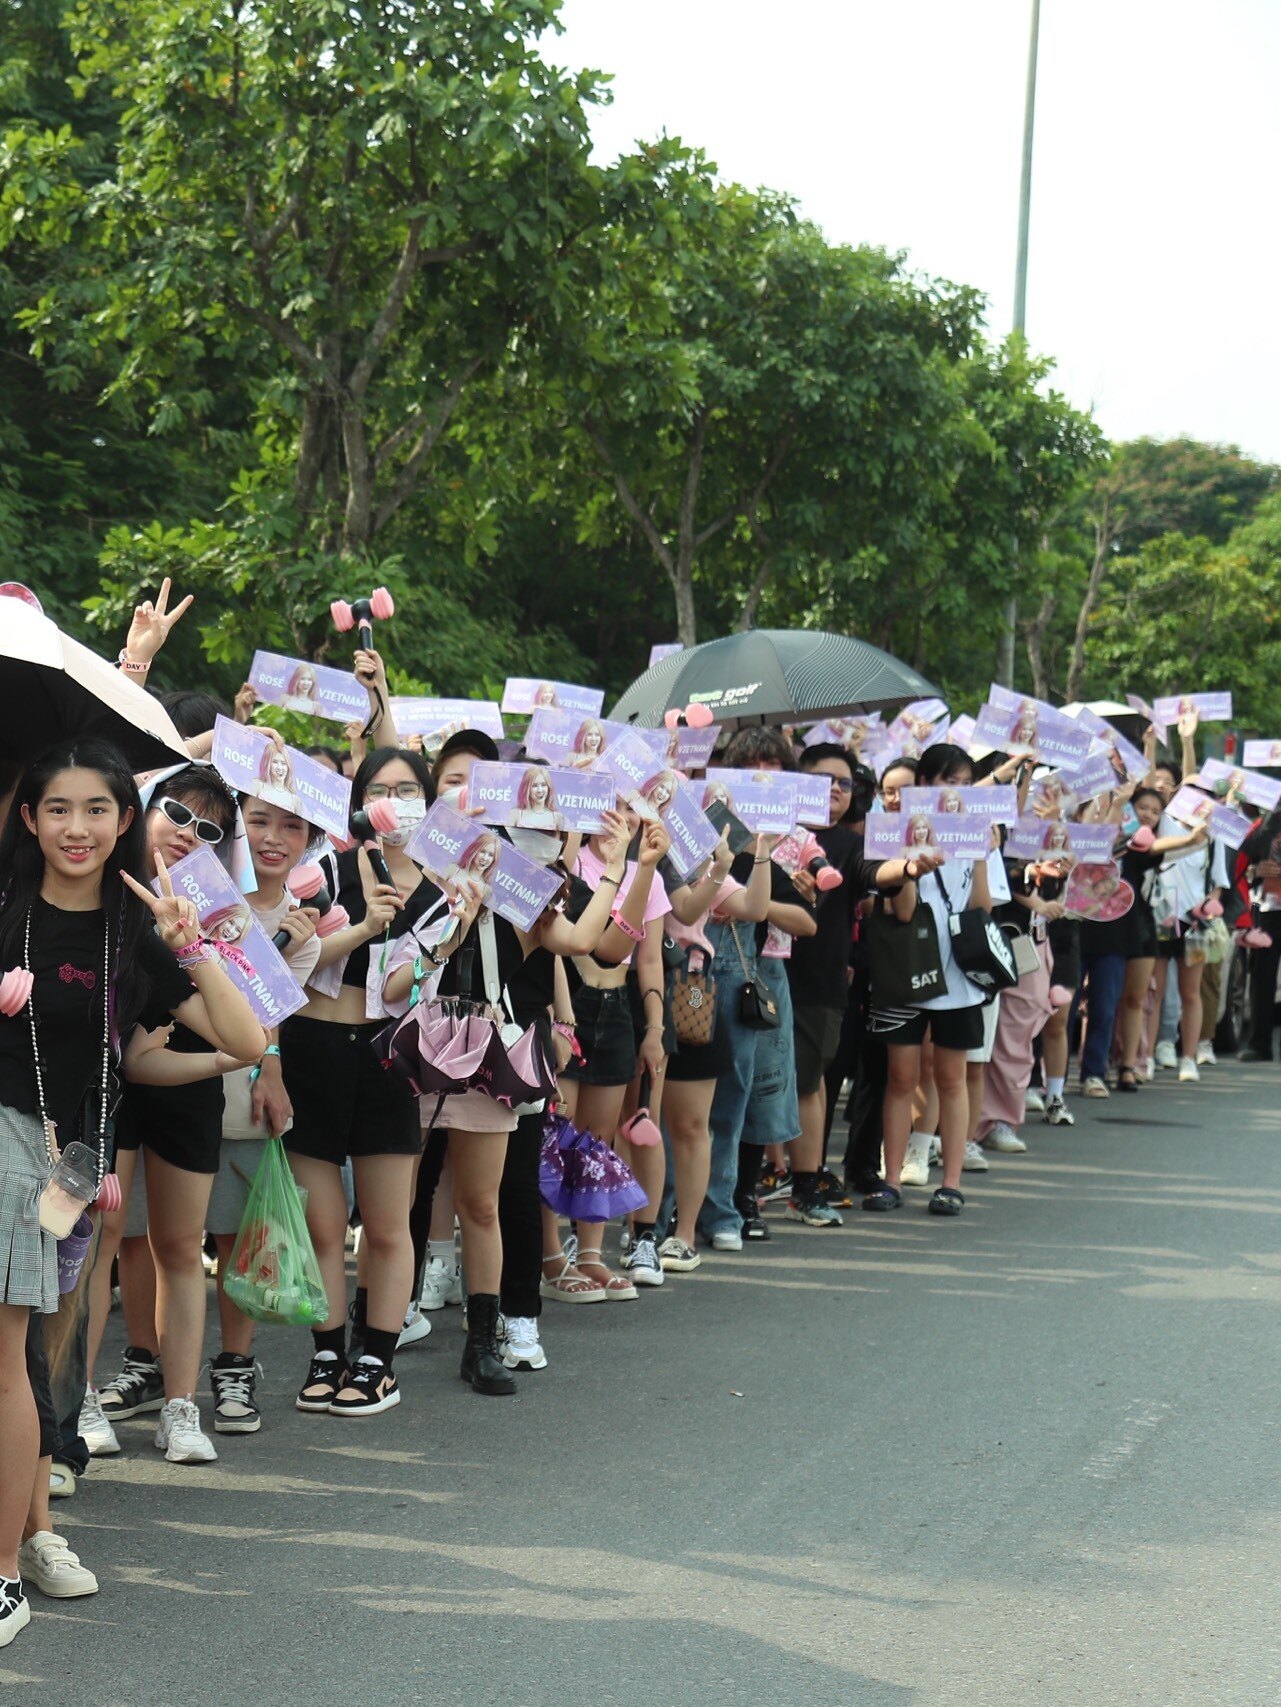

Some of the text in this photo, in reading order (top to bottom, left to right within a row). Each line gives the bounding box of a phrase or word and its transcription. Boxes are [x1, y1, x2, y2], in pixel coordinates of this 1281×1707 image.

[258, 672, 366, 709] ROSÉ VIETNAM
[559, 699, 598, 712] VIETNAM
[540, 732, 570, 747] ROSÉ
[678, 745, 711, 754] VIETNAM
[983, 723, 1084, 758] ROSÉ VIETNAM
[223, 747, 345, 816] ROSÉ VIETNAM
[479, 785, 609, 811] ROSÉ VIETNAM
[614, 754, 703, 859] ROSÉ VIETNAM
[966, 803, 1012, 814] VIETNAM
[735, 803, 789, 816] VIETNAM
[875, 830, 984, 843] ROSÉ VIETNAM
[1015, 833, 1110, 850] ROSÉ VIETNAM
[428, 828, 542, 908] ROSÉ VIETNAM
[180, 873, 214, 912] ROSÉ
[911, 969, 939, 990] SAT
